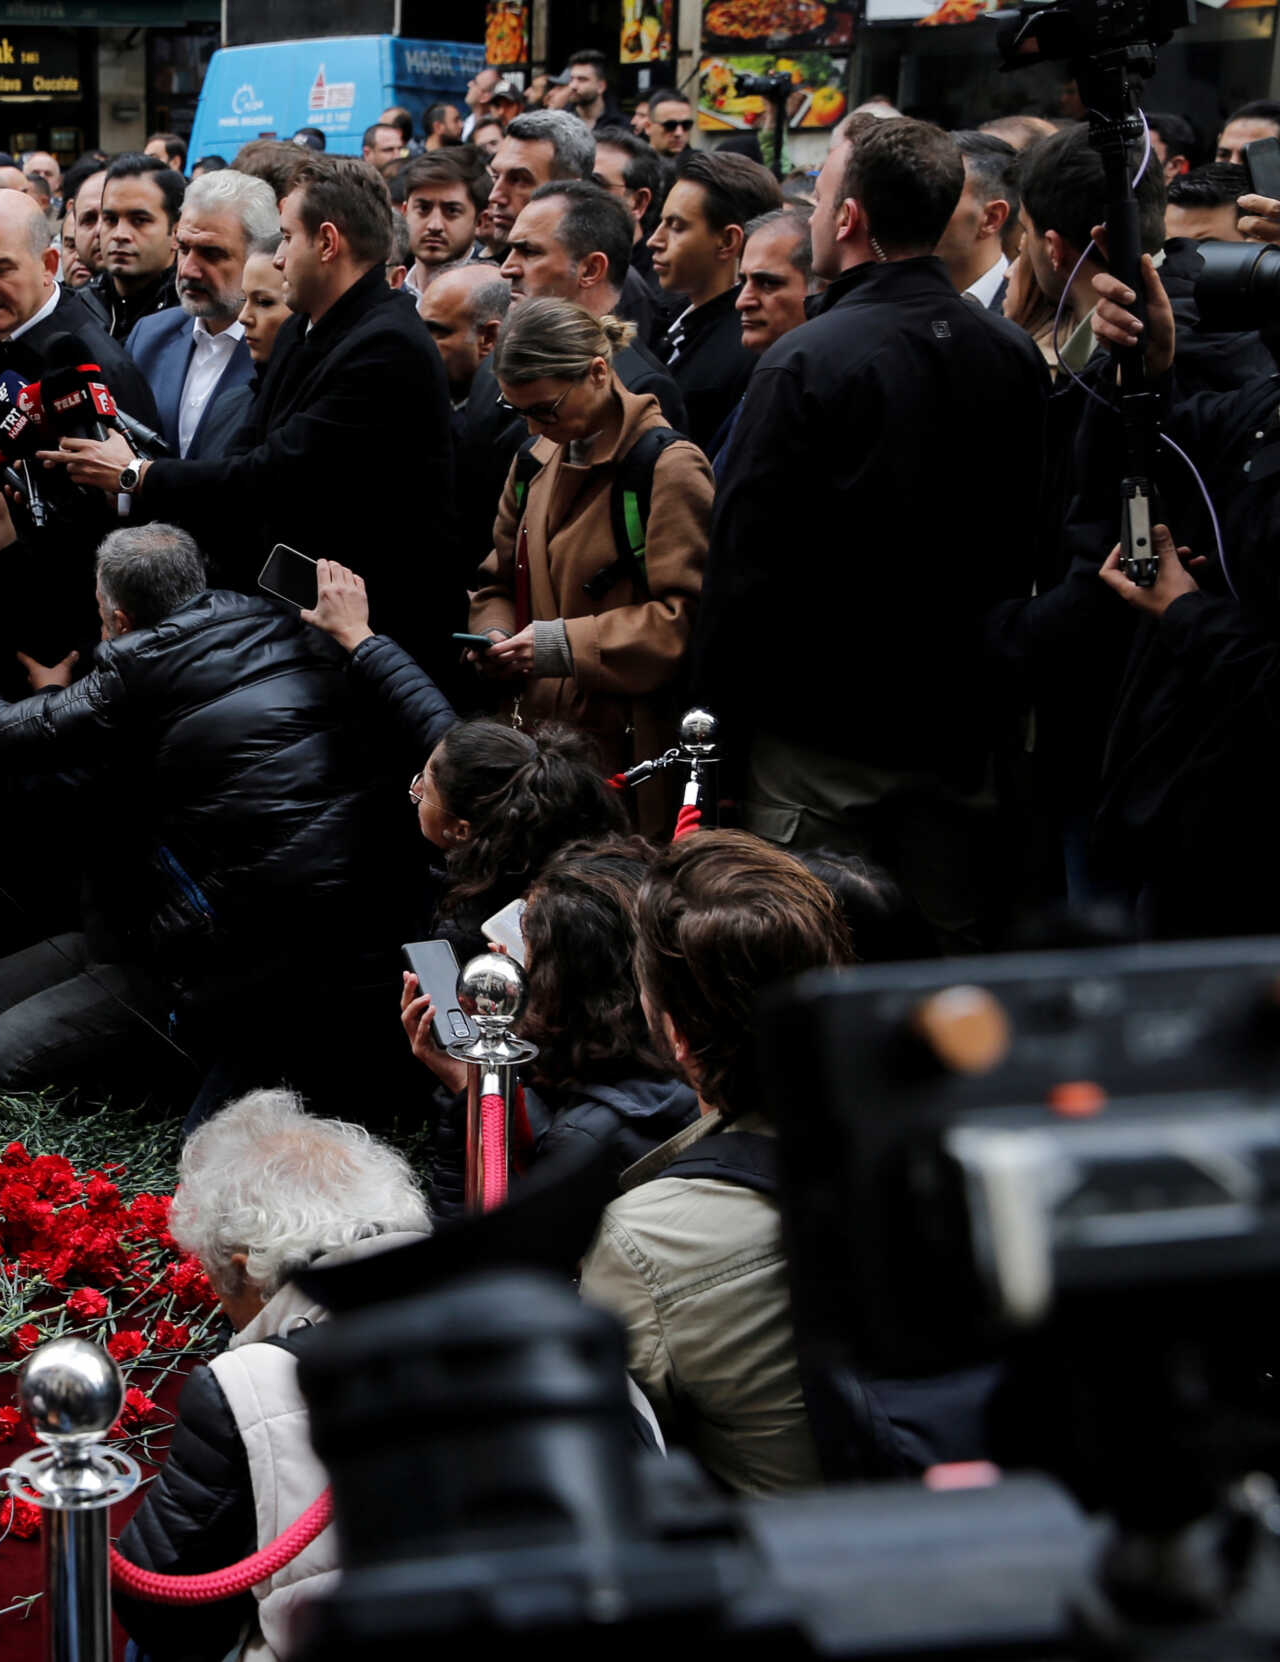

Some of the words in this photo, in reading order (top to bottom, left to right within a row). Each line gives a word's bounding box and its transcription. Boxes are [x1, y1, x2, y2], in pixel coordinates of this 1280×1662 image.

[32, 76, 80, 92] Chocolate
[53, 392, 81, 411] TELE
[0, 407, 21, 431] TRT
